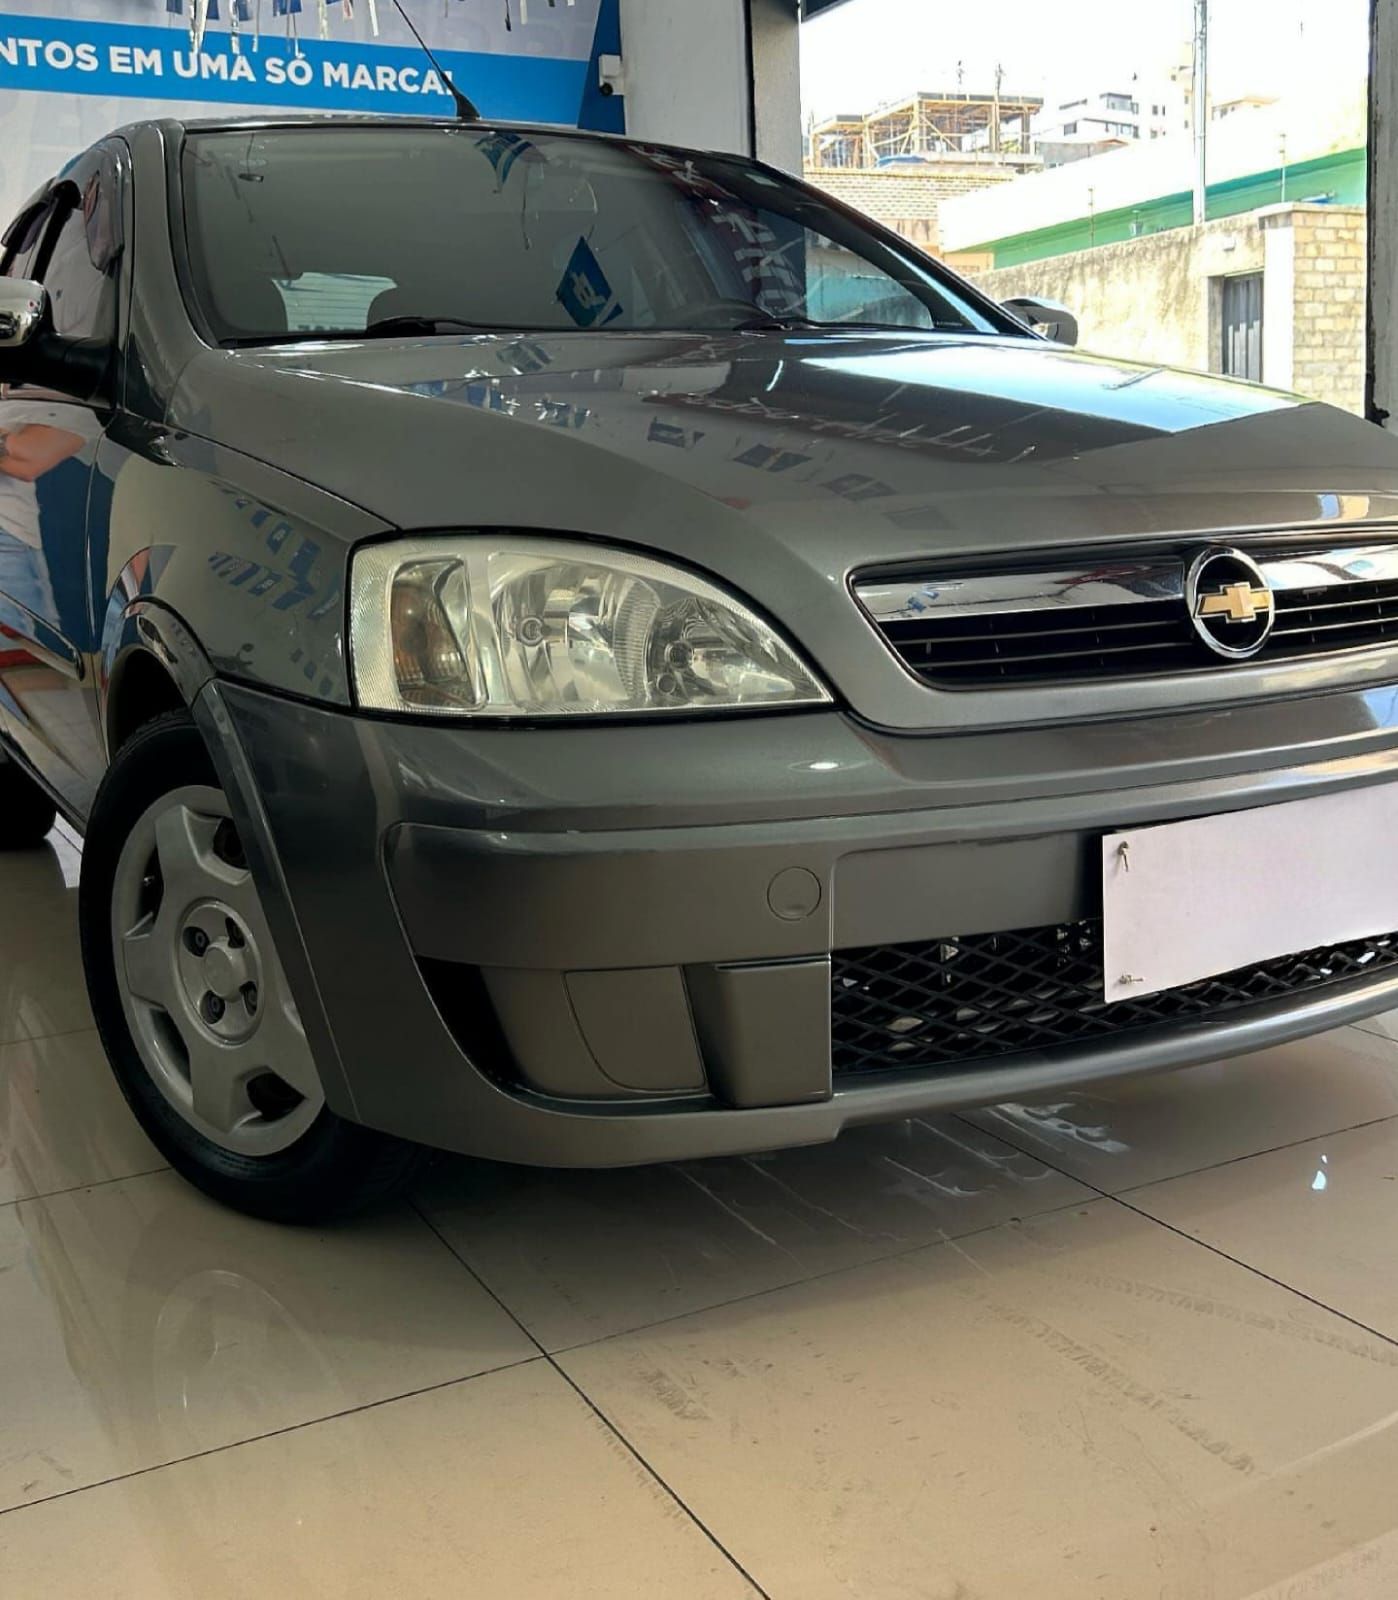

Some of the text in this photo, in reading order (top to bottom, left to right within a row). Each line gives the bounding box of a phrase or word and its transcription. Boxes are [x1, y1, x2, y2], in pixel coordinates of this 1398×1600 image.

[109, 46, 163, 75] EM
[173, 51, 256, 81] UMA
[265, 53, 313, 86] SÓ
